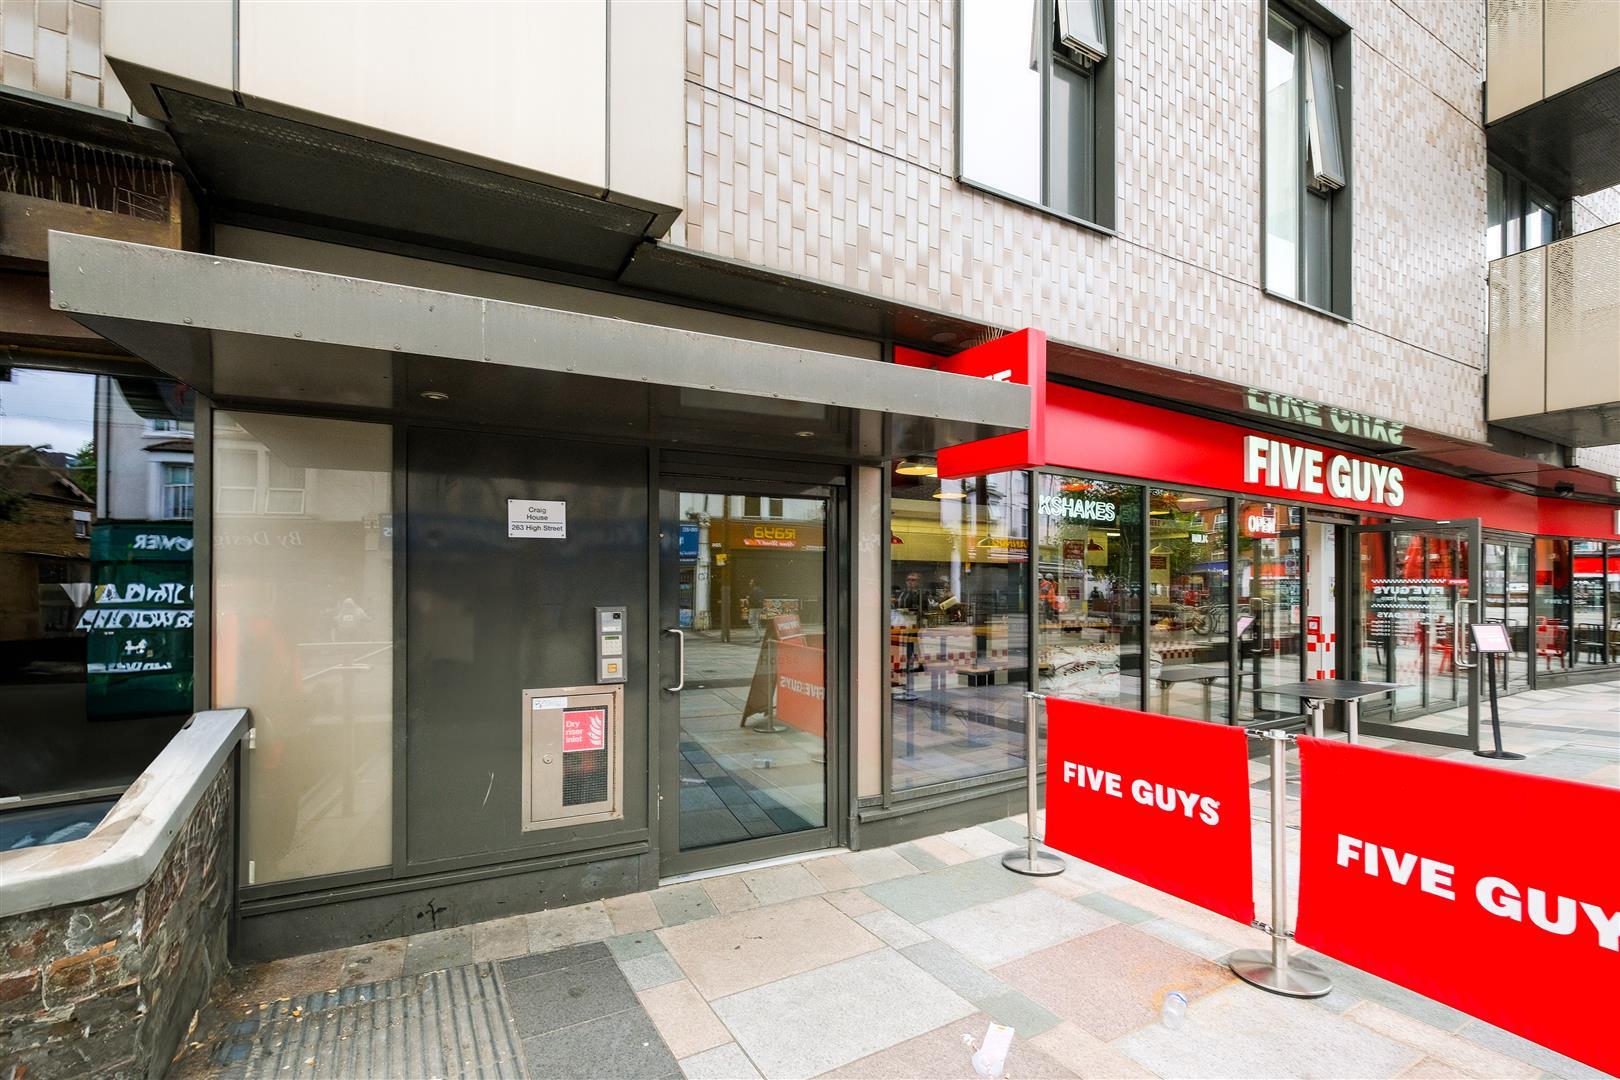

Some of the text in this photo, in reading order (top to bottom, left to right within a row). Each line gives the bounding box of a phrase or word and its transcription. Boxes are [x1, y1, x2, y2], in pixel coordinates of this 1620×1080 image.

[1244, 435, 1405, 507] FIVE GUYS
[528, 506, 547, 515] Craig
[1038, 495, 1116, 522] KSHAKES
[525, 524, 542, 532] High
[1248, 515, 1276, 534] OPEN
[566, 720, 581, 730] Dry
[566, 735, 583, 743] inlet
[1063, 760, 1220, 826] FIVE GUYS
[1336, 833, 1620, 952] FIVE GUY
